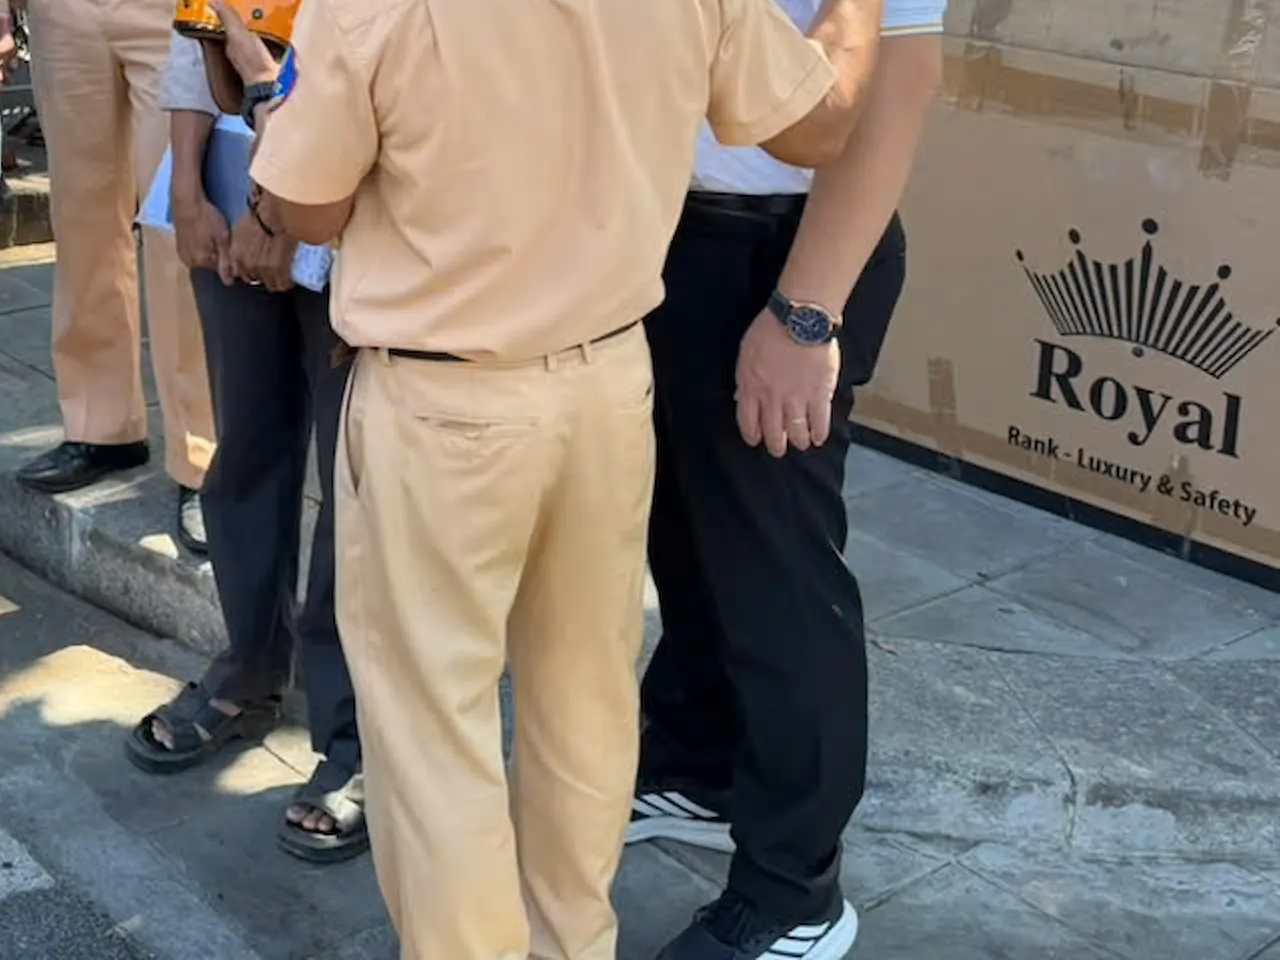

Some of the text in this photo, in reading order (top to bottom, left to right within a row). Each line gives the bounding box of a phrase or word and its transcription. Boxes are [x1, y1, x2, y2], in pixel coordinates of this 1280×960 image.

[1029, 338, 1241, 458] Royal
[1007, 425, 1059, 460] Rank
[1076, 447, 1152, 492] Luxury
[1156, 474, 1174, 497] &
[1180, 481, 1258, 527] Safety
